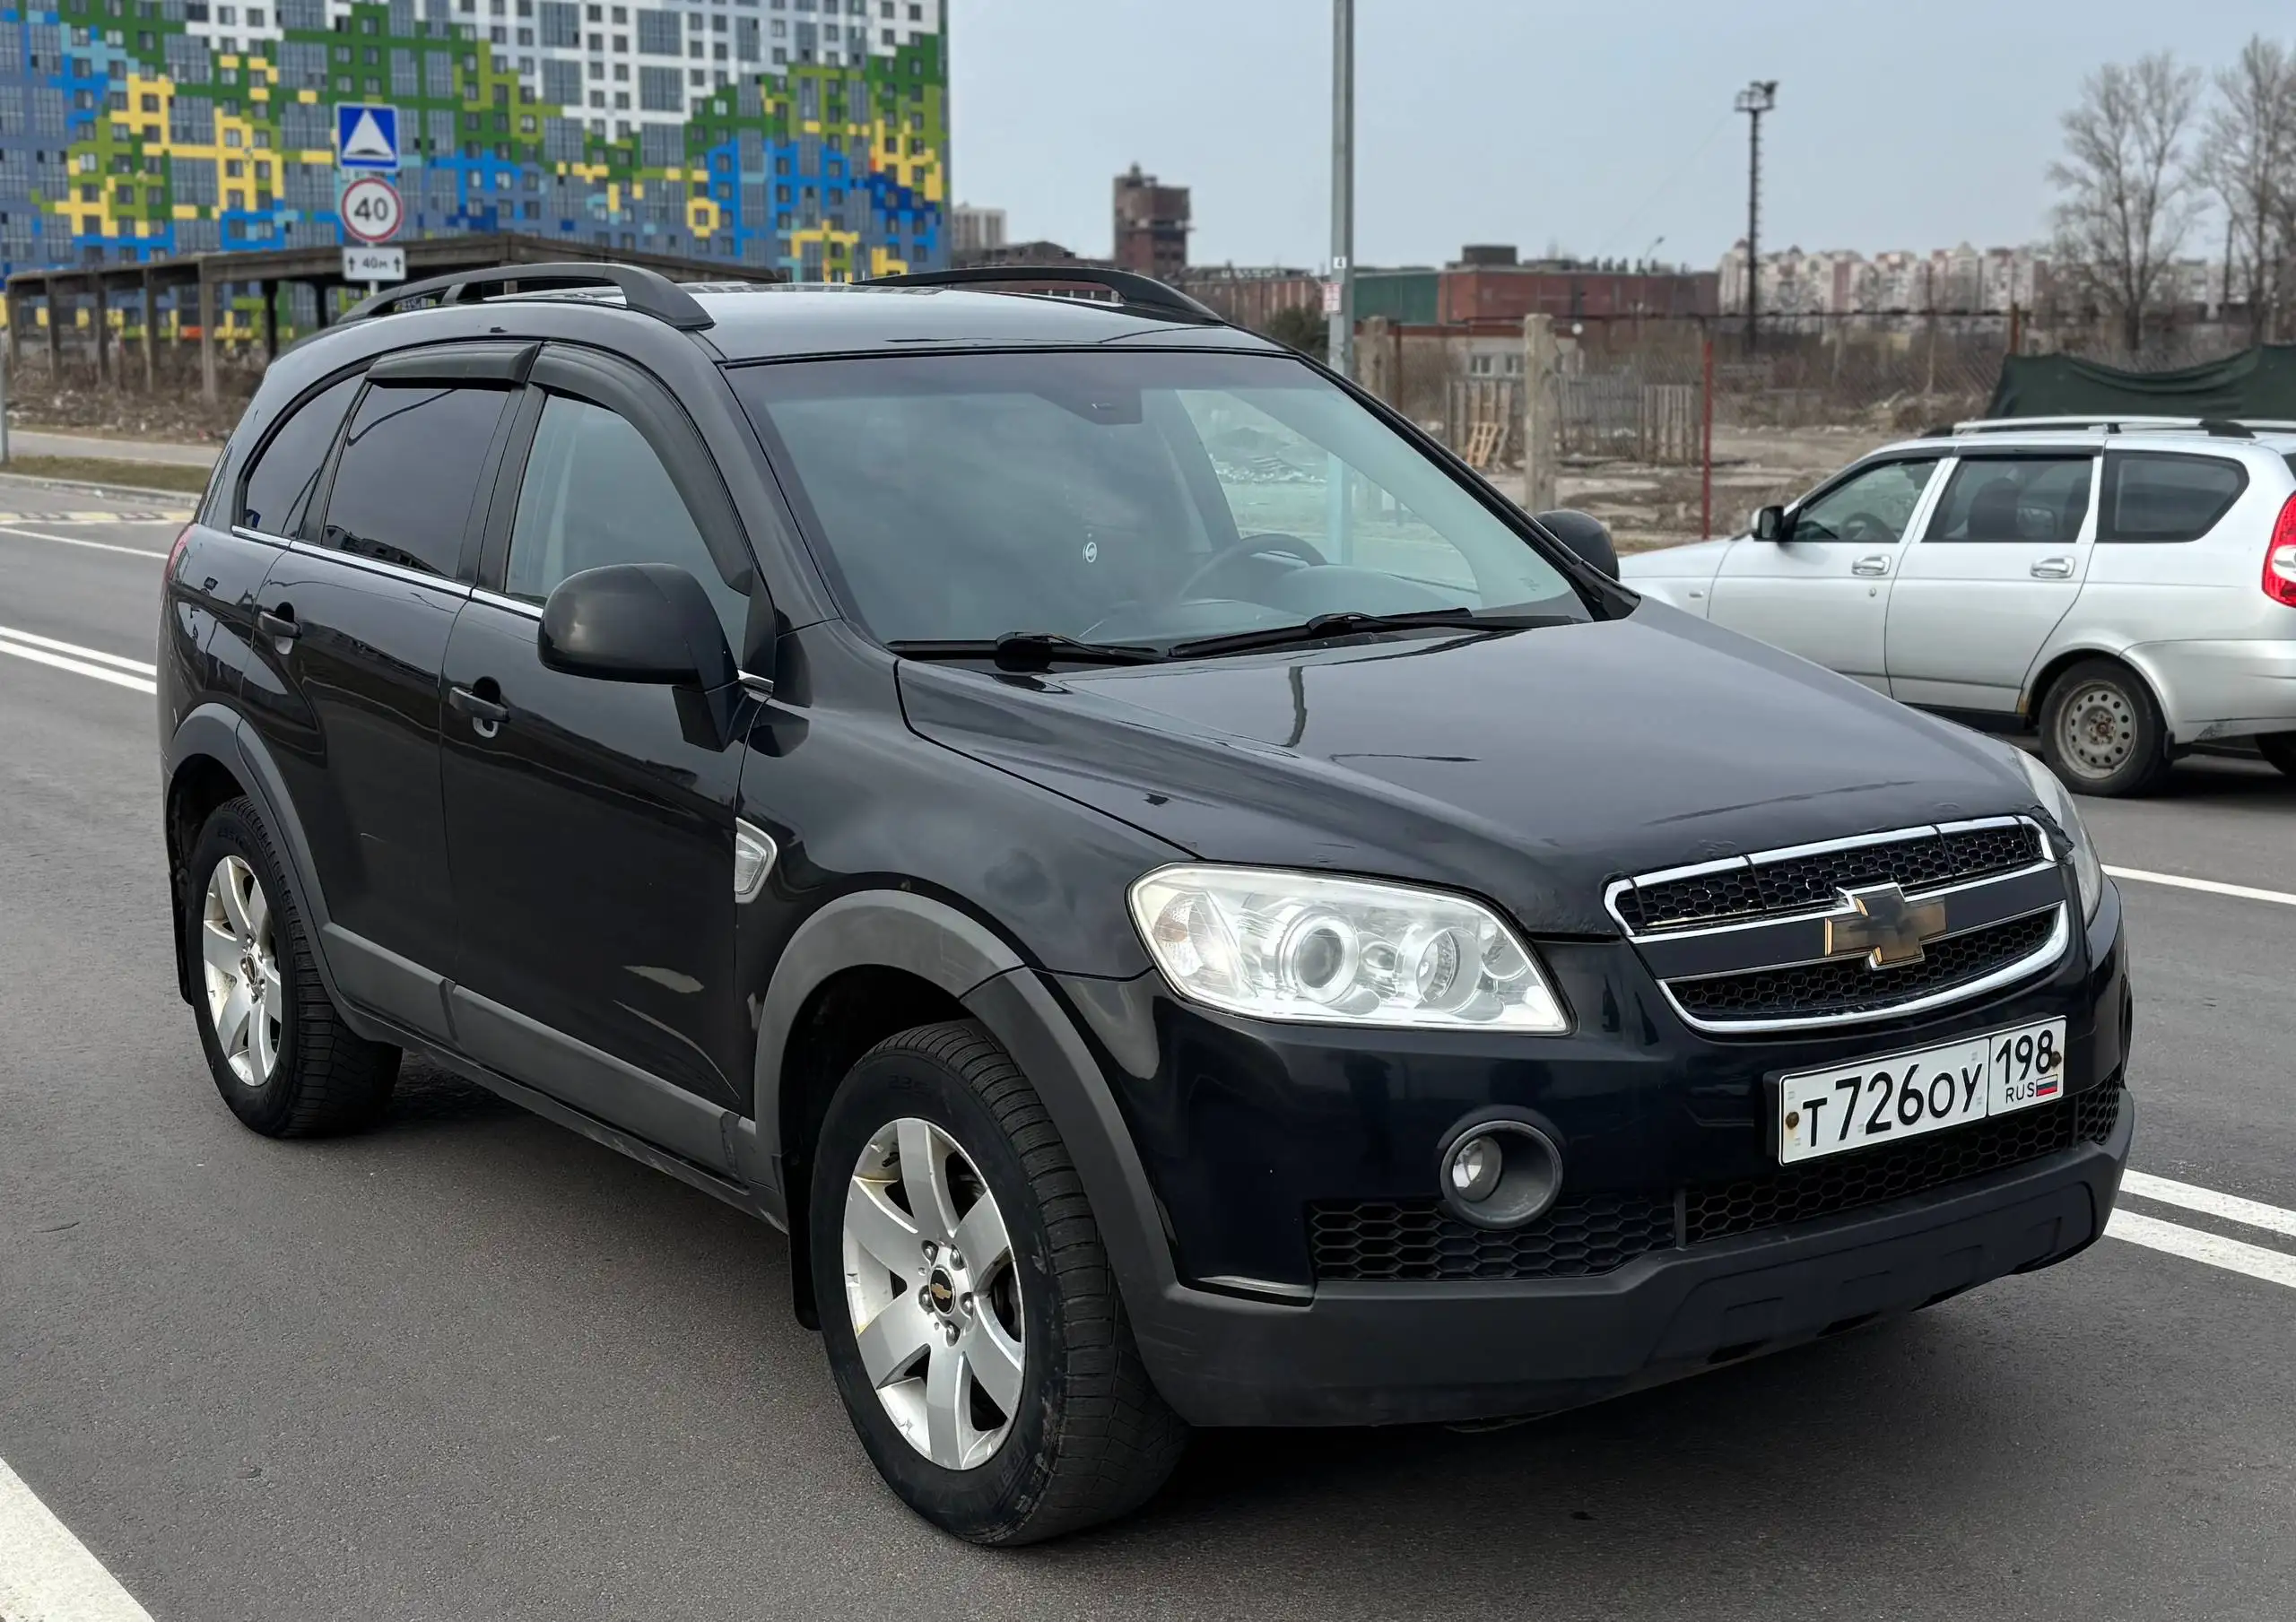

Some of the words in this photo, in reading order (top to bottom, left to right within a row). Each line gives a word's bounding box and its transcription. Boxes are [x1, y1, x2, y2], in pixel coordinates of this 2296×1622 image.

[353, 197, 388, 221] 40
[1996, 1029, 2054, 1084] 198
[2005, 1081, 2035, 1104] RUS
